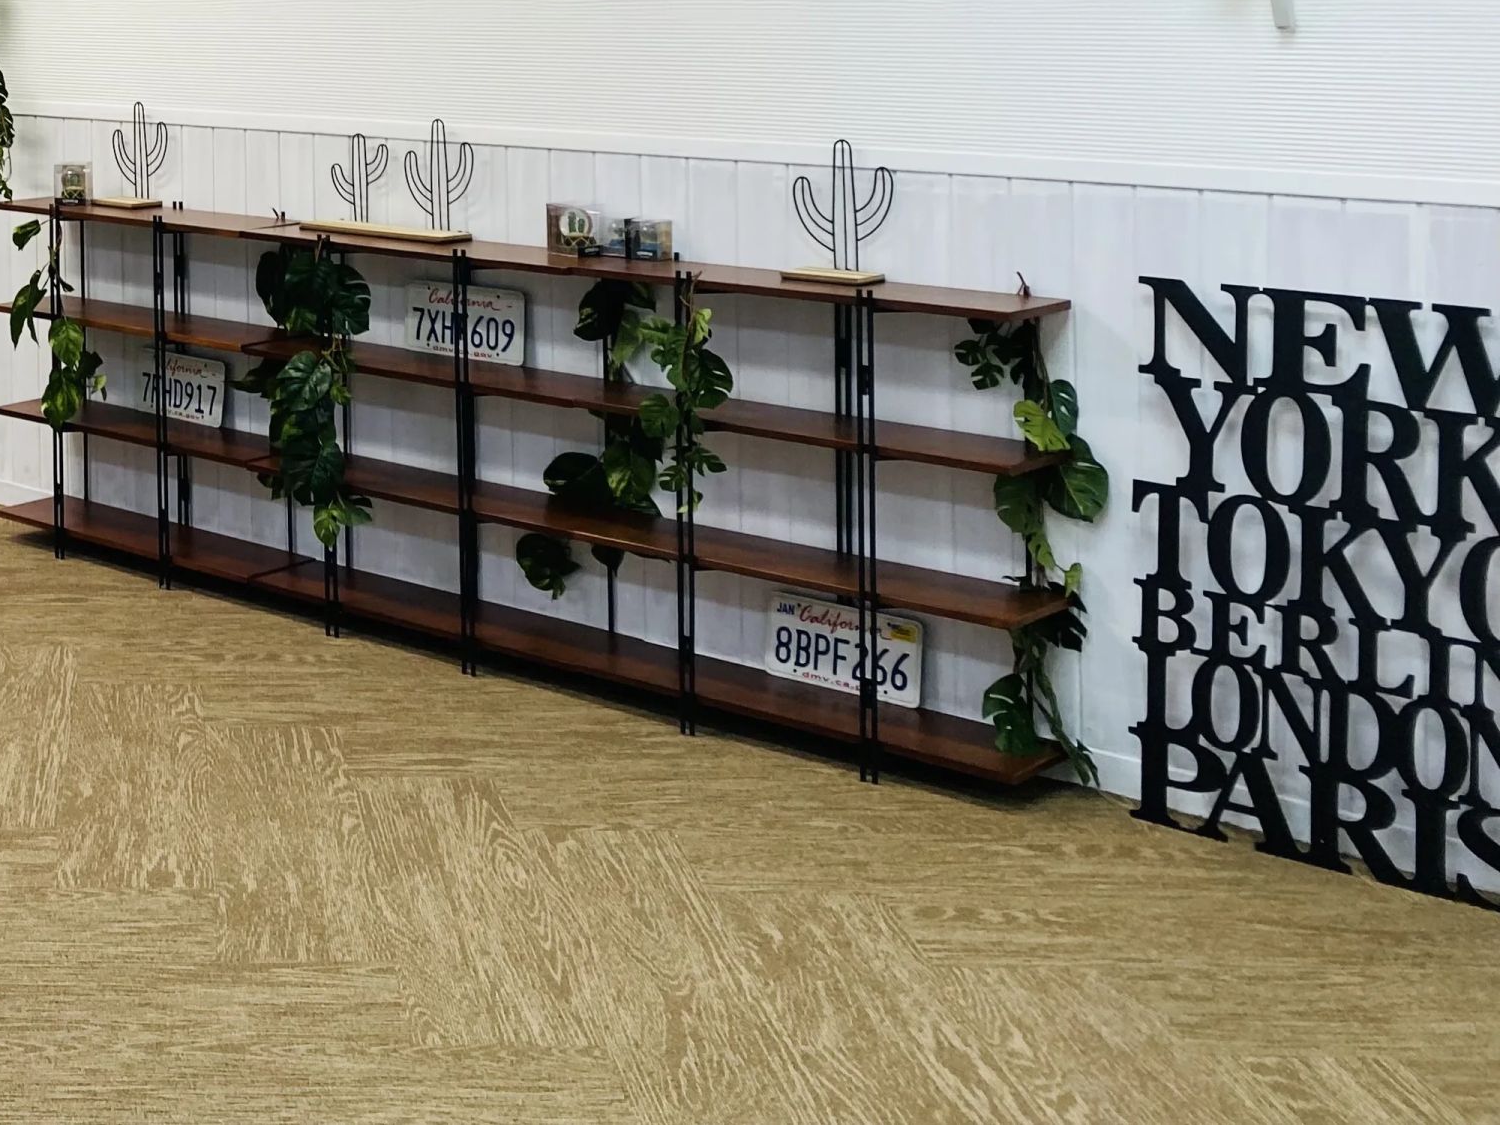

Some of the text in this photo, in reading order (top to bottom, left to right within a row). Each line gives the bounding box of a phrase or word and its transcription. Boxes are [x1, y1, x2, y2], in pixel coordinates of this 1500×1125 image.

[412, 307, 515, 352] 7XH609
[1138, 276, 1500, 418] NEW
[1153, 374, 1500, 535] YORK
[776, 602, 796, 616] JAN
[775, 626, 911, 691] 8BPF266
[801, 671, 861, 691] dmv.ca.
[1127, 723, 1500, 914] PARIS
